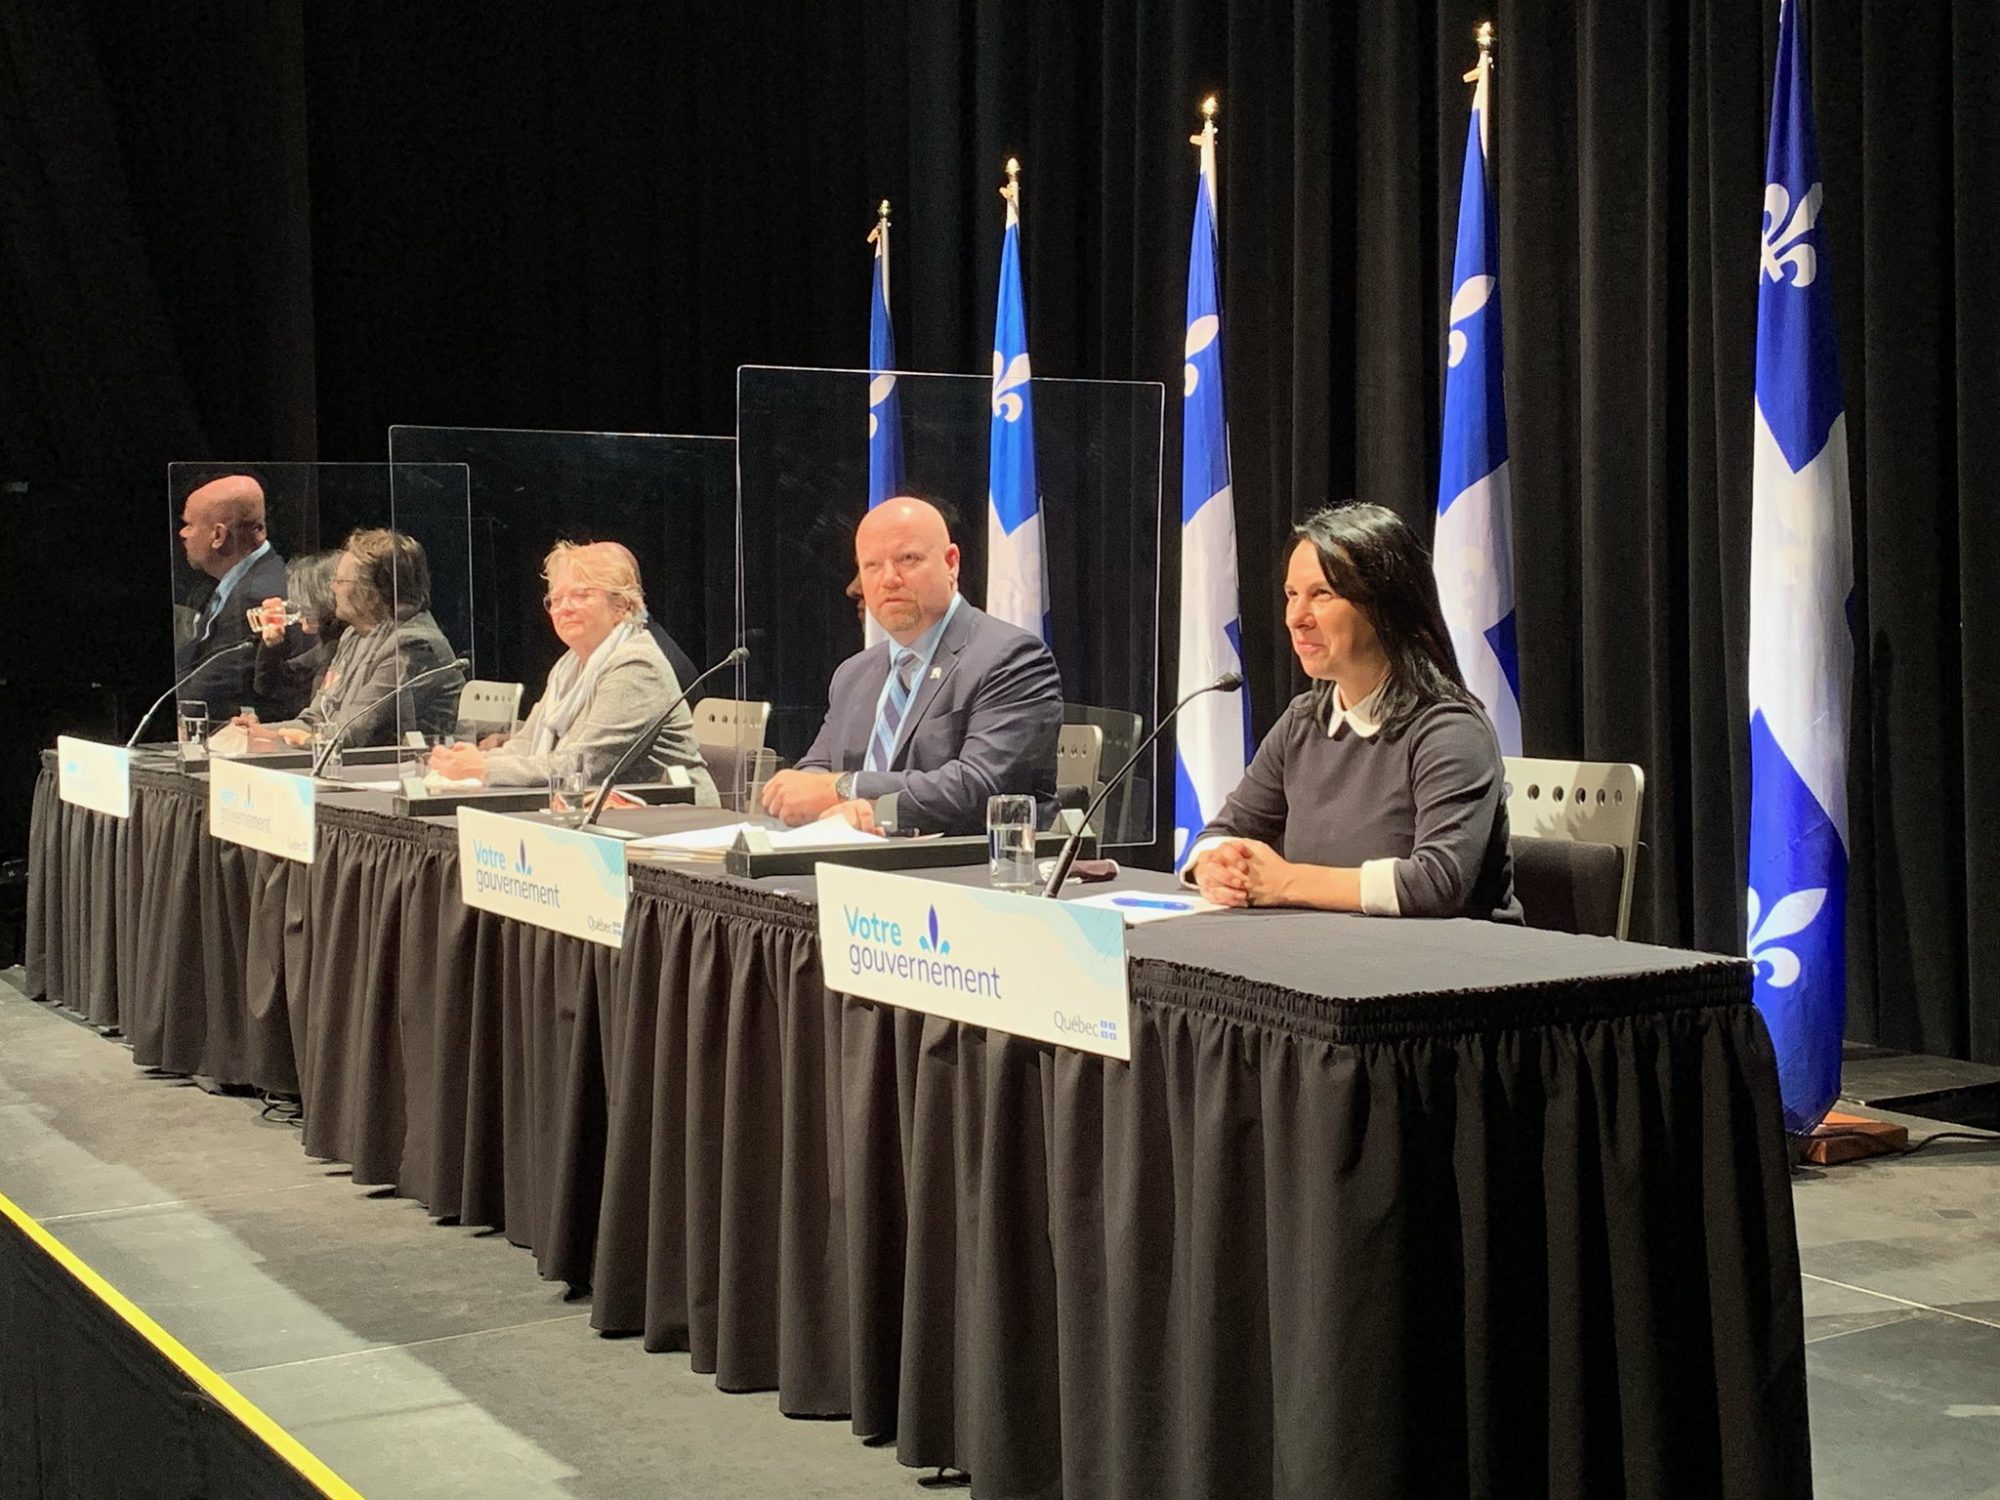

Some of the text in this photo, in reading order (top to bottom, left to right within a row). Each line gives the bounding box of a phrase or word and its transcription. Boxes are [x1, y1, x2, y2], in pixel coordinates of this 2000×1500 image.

[473, 838, 507, 871] Votre
[476, 868, 561, 909] gouvernement
[586, 914, 612, 933] Québec
[844, 903, 902, 947] Votre
[848, 943, 1002, 999] gouvernement
[1053, 1010, 1099, 1039] Québec
